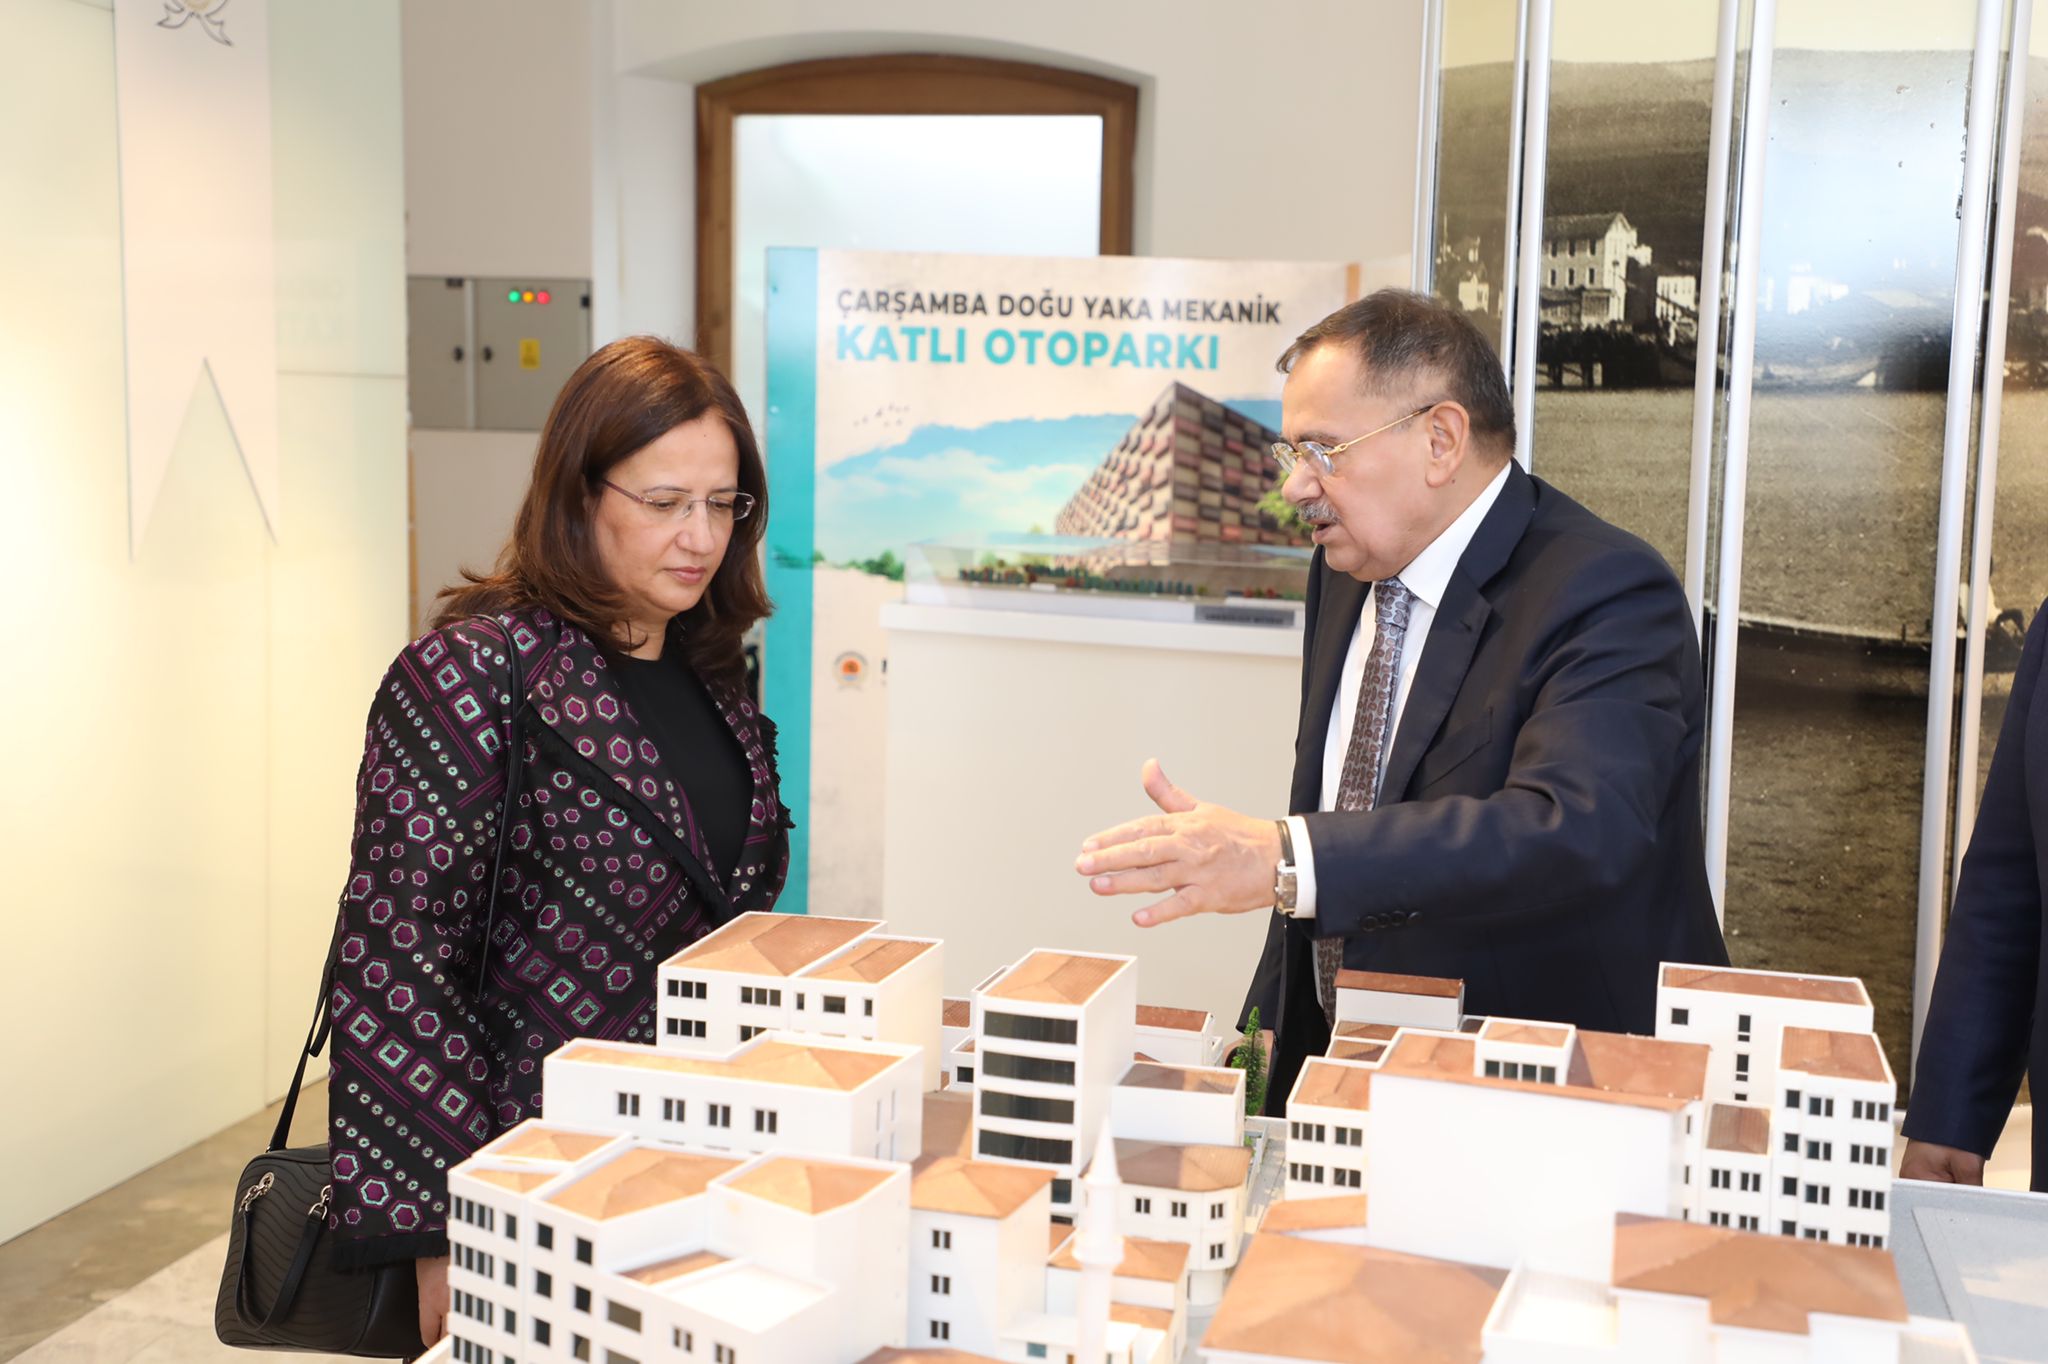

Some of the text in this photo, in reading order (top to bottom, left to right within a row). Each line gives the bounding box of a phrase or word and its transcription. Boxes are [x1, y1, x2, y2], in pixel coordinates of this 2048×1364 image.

[838, 289, 1280, 324] ÇARŞAMBA DOĞU YAKA MEKANİK
[836, 323, 1219, 370] KATLI OTOPARKI
